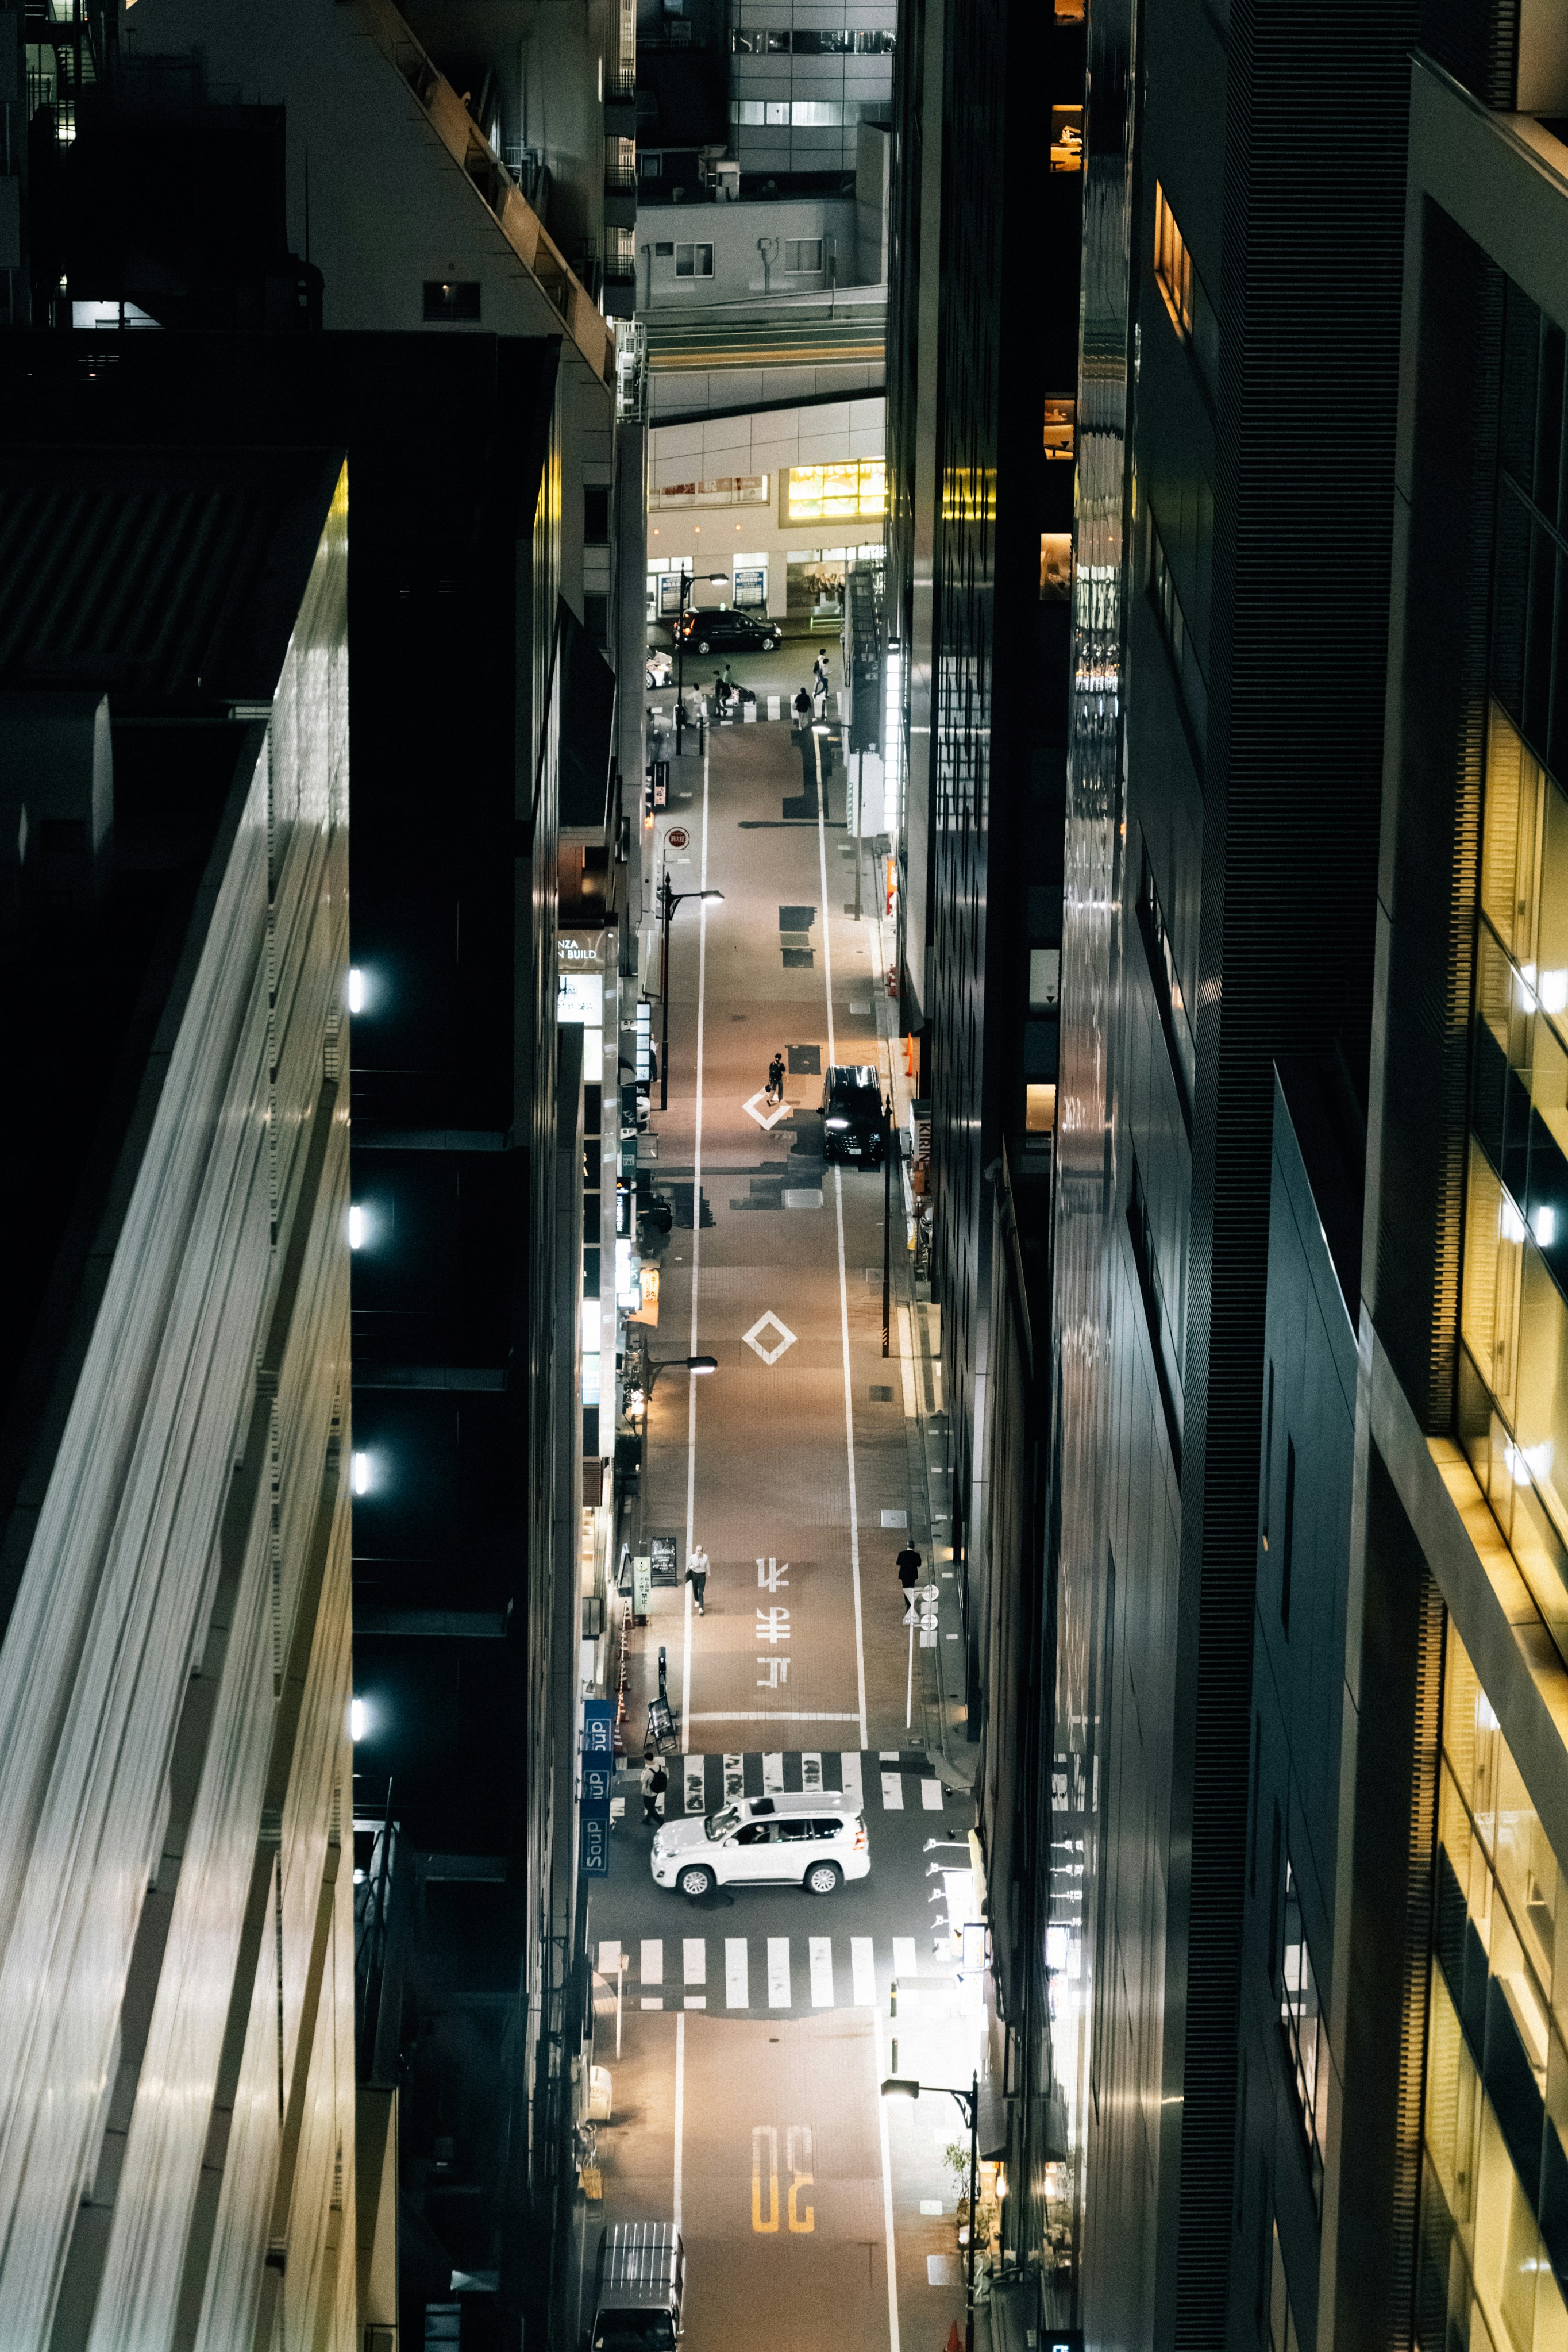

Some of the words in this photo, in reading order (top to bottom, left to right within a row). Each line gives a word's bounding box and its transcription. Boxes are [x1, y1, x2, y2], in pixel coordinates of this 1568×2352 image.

[568, 950, 596, 959] BUILD
[919, 1123, 930, 1162] KIRIN
[587, 1822, 602, 1868] Soup
[752, 2125, 815, 2233] 30
